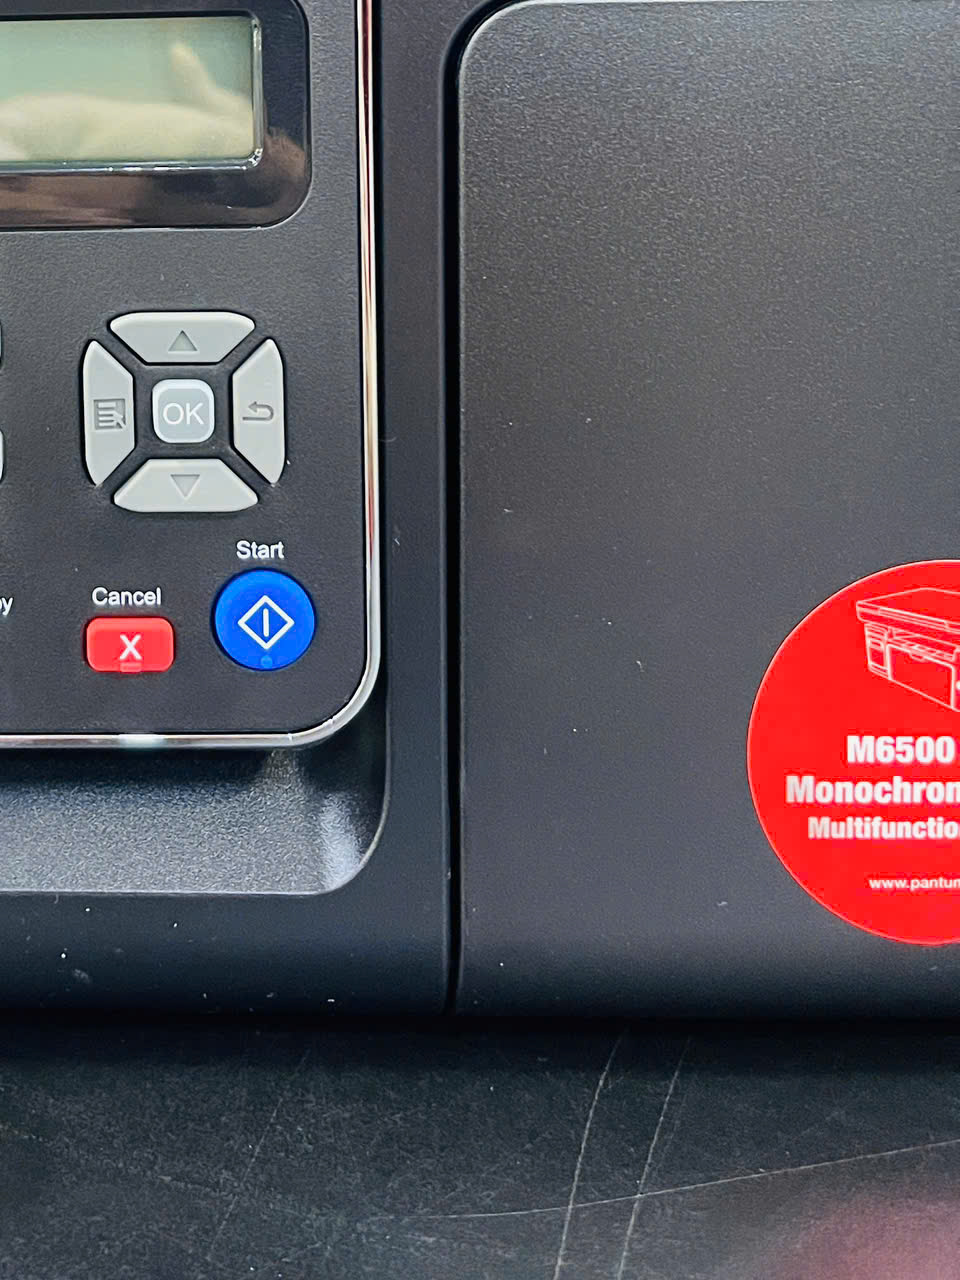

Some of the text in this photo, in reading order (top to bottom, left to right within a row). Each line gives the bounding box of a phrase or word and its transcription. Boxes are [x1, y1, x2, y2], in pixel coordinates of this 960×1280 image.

[162, 402, 205, 425] OK
[236, 540, 285, 560] Start
[92, 587, 162, 606] Cancel
[847, 735, 956, 764] M6500
[808, 816, 960, 840] Multifunctio
